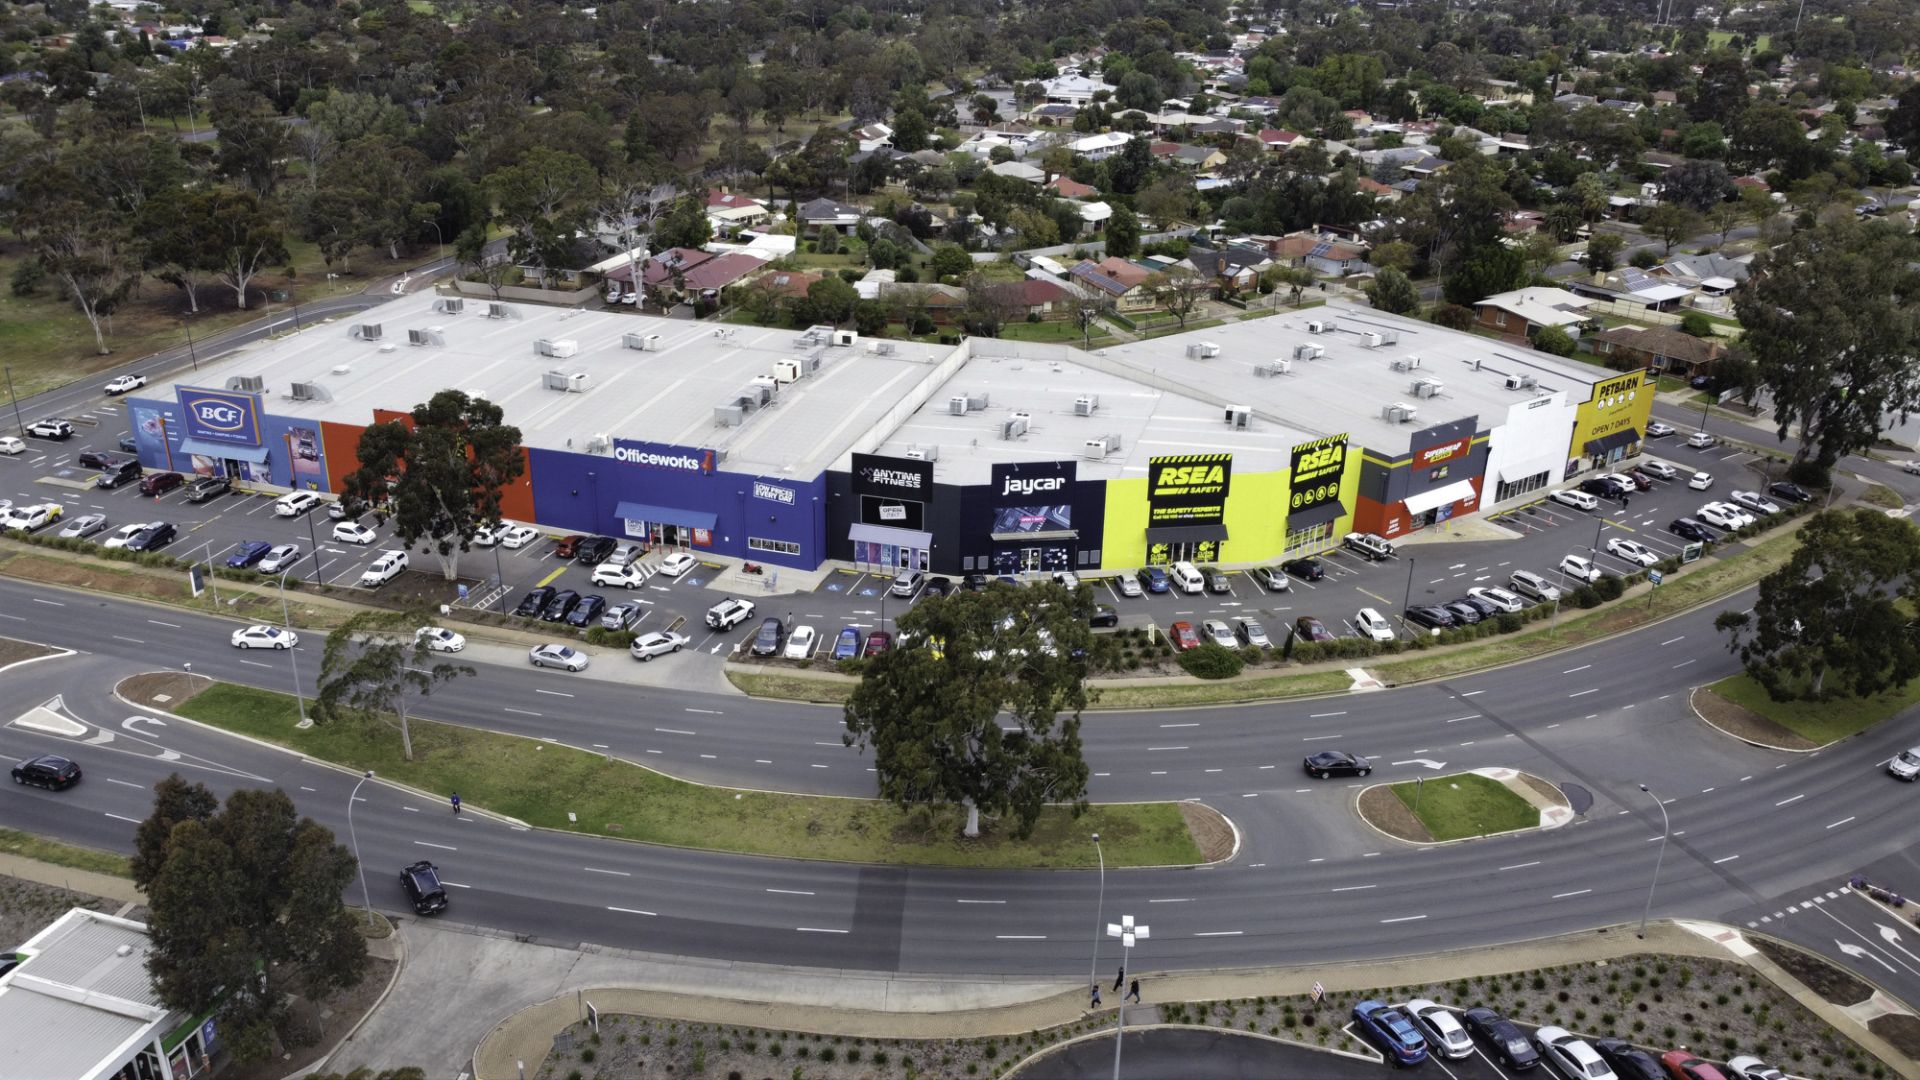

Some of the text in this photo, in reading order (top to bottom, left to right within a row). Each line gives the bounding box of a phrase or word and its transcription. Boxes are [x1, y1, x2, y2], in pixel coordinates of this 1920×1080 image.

[1600, 377, 1639, 398] PETBARN
[201, 407, 238, 422] BCF
[1592, 424, 1610, 436] OPEN
[1615, 417, 1631, 428] DAYS
[615, 447, 699, 470] Officeworks
[1297, 445, 1342, 473] RSEA
[873, 468, 921, 481] ANYTIME
[1158, 465, 1223, 486] RSEA
[1319, 464, 1341, 476] SAFETY
[873, 476, 921, 488] FITNESS
[1002, 475, 1066, 496] jaycar
[1190, 486, 1223, 494] SAFETY
[1192, 505, 1221, 513] EXPERTS
